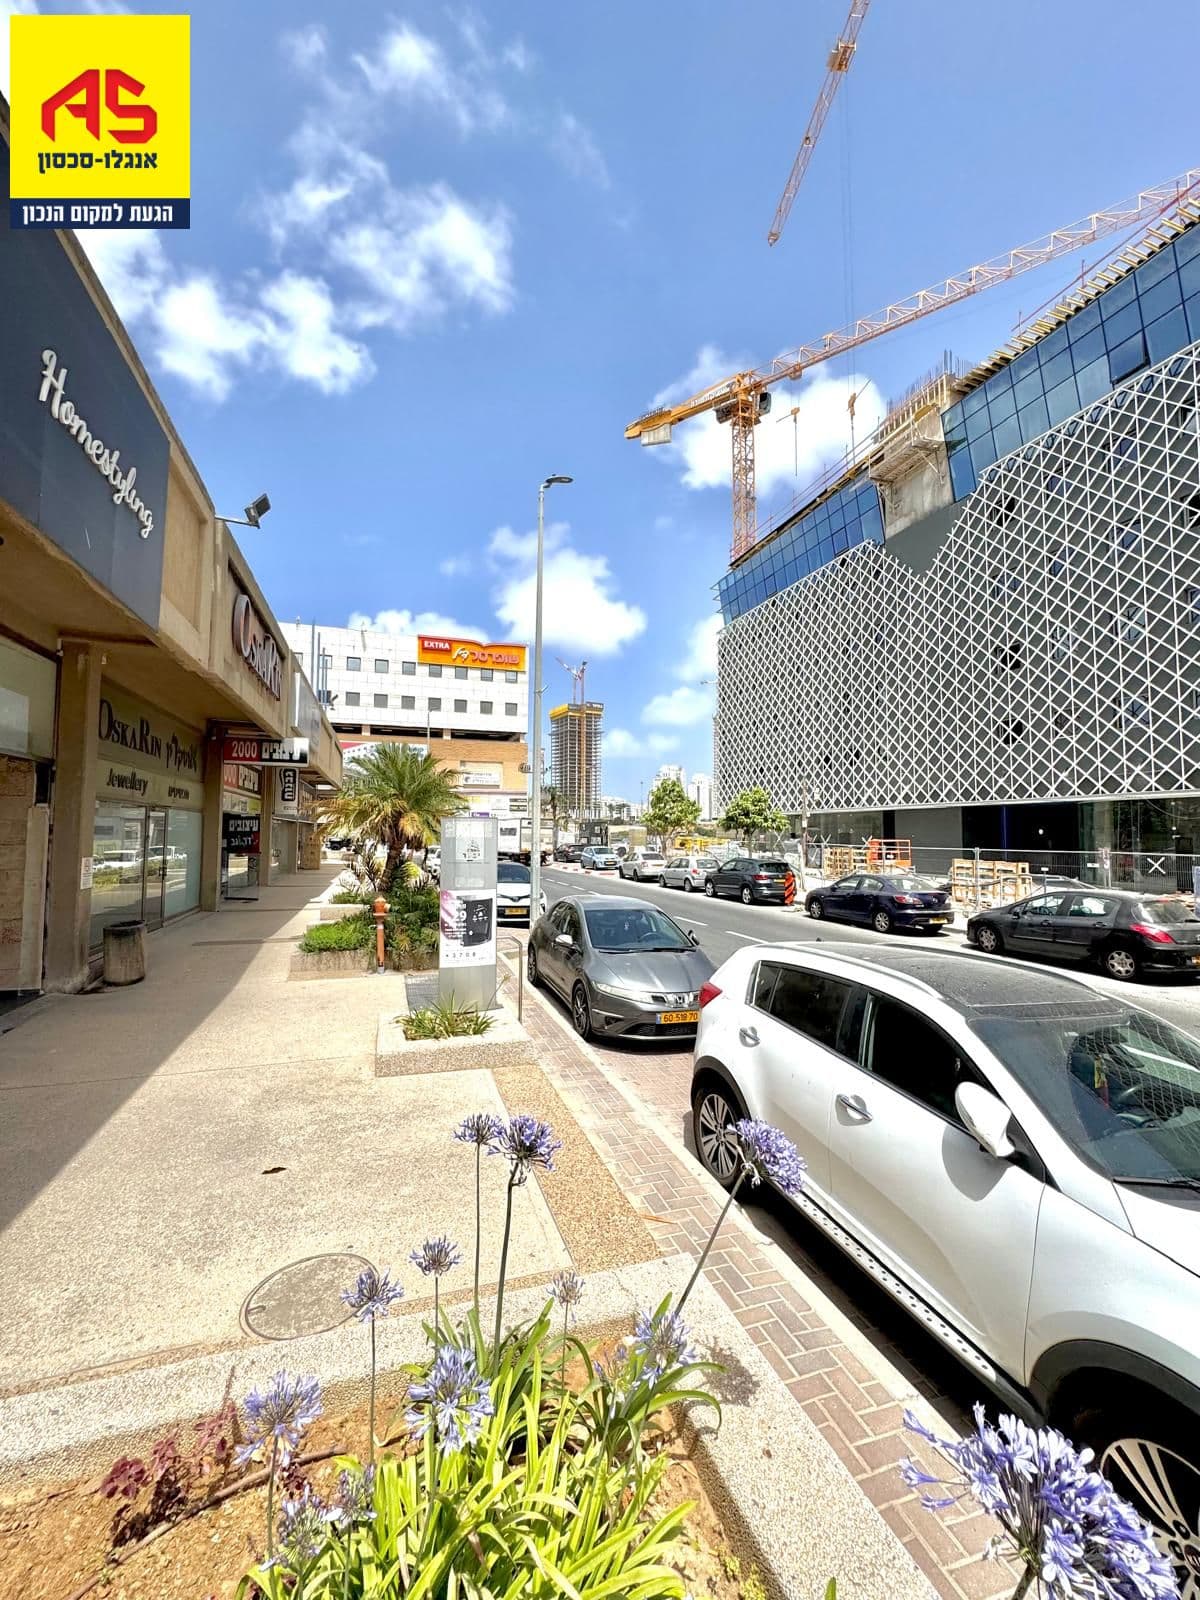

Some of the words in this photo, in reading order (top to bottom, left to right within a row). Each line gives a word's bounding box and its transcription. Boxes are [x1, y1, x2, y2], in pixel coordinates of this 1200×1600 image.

[38, 349, 154, 539] Homestyling
[423, 640, 450, 650] EXTRA
[232, 741, 258, 758] 2000
[106, 767, 148, 796] Jewellery
[229, 819, 259, 832] עיצובים
